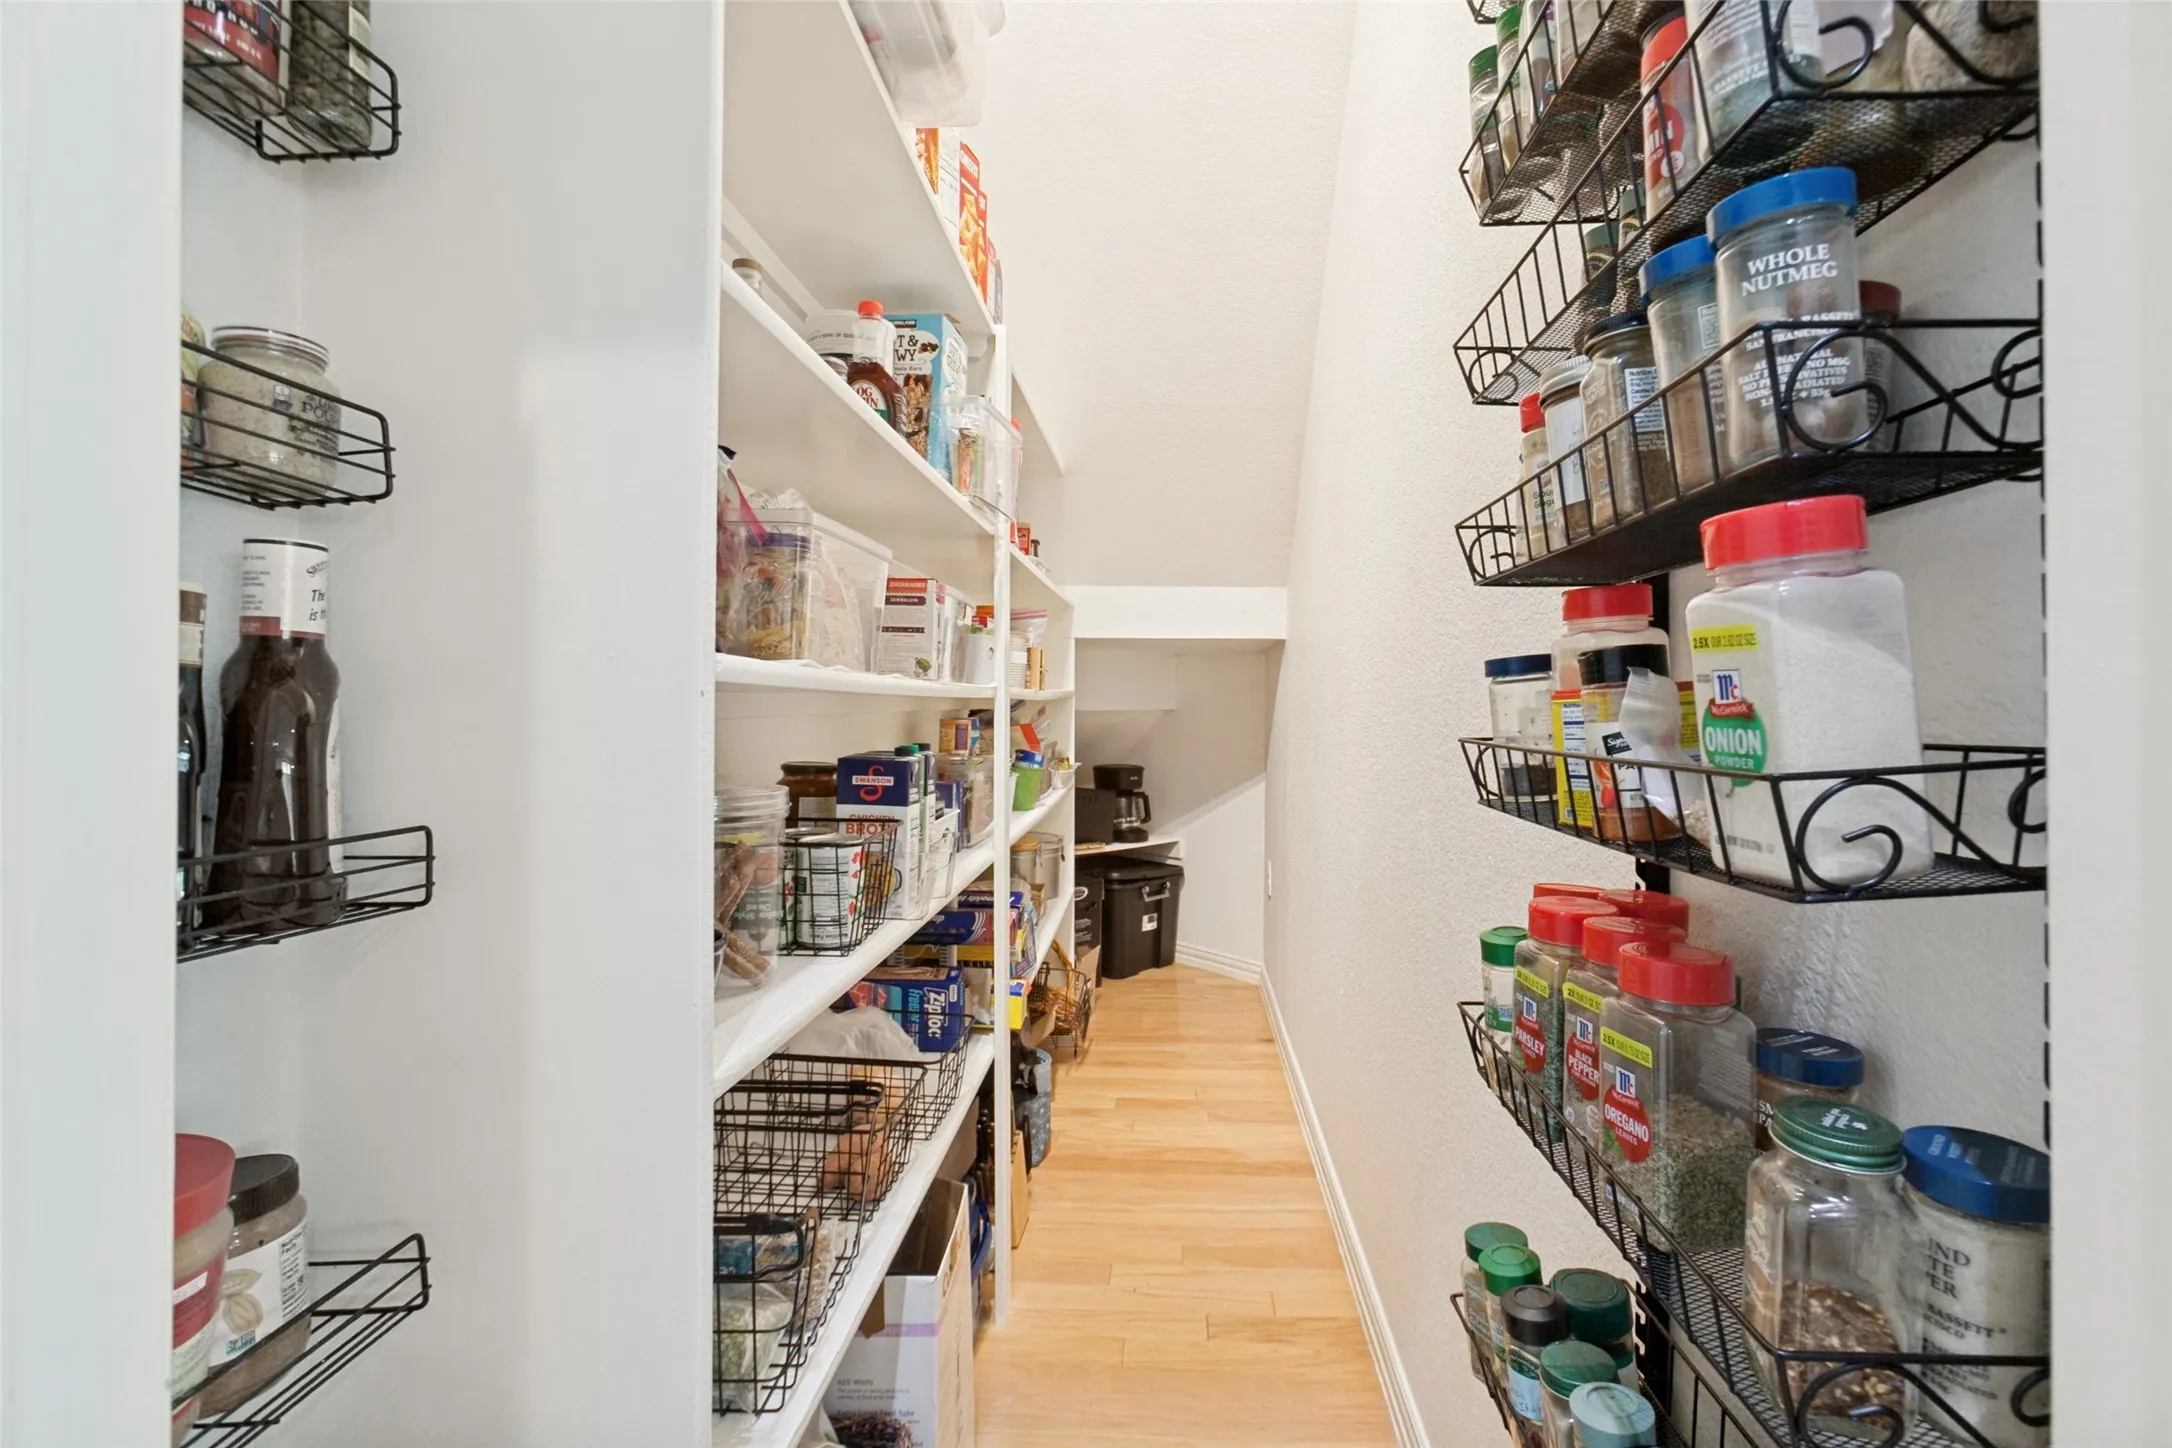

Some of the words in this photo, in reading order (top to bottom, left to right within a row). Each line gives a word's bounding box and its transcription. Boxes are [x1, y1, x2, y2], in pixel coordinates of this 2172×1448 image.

[1747, 243, 1830, 276] WHOLE
[1741, 260, 1838, 297] NUTMEG
[1693, 636, 1710, 650] 2.5X
[1710, 702, 1750, 715] McCormick
[1704, 726, 1763, 756] ONION
[1714, 754, 1755, 770] POWDER
[855, 776, 893, 785] SWANSON
[1515, 1026, 1545, 1057] PARSLEY
[1568, 1055, 1600, 1084] PEPPER
[1574, 1049, 1593, 1067] BLACK
[1604, 1103, 1650, 1143] OREGANO
[1614, 1126, 1638, 1147] LEAVES
[1926, 1302, 1996, 1339] BASSETT
